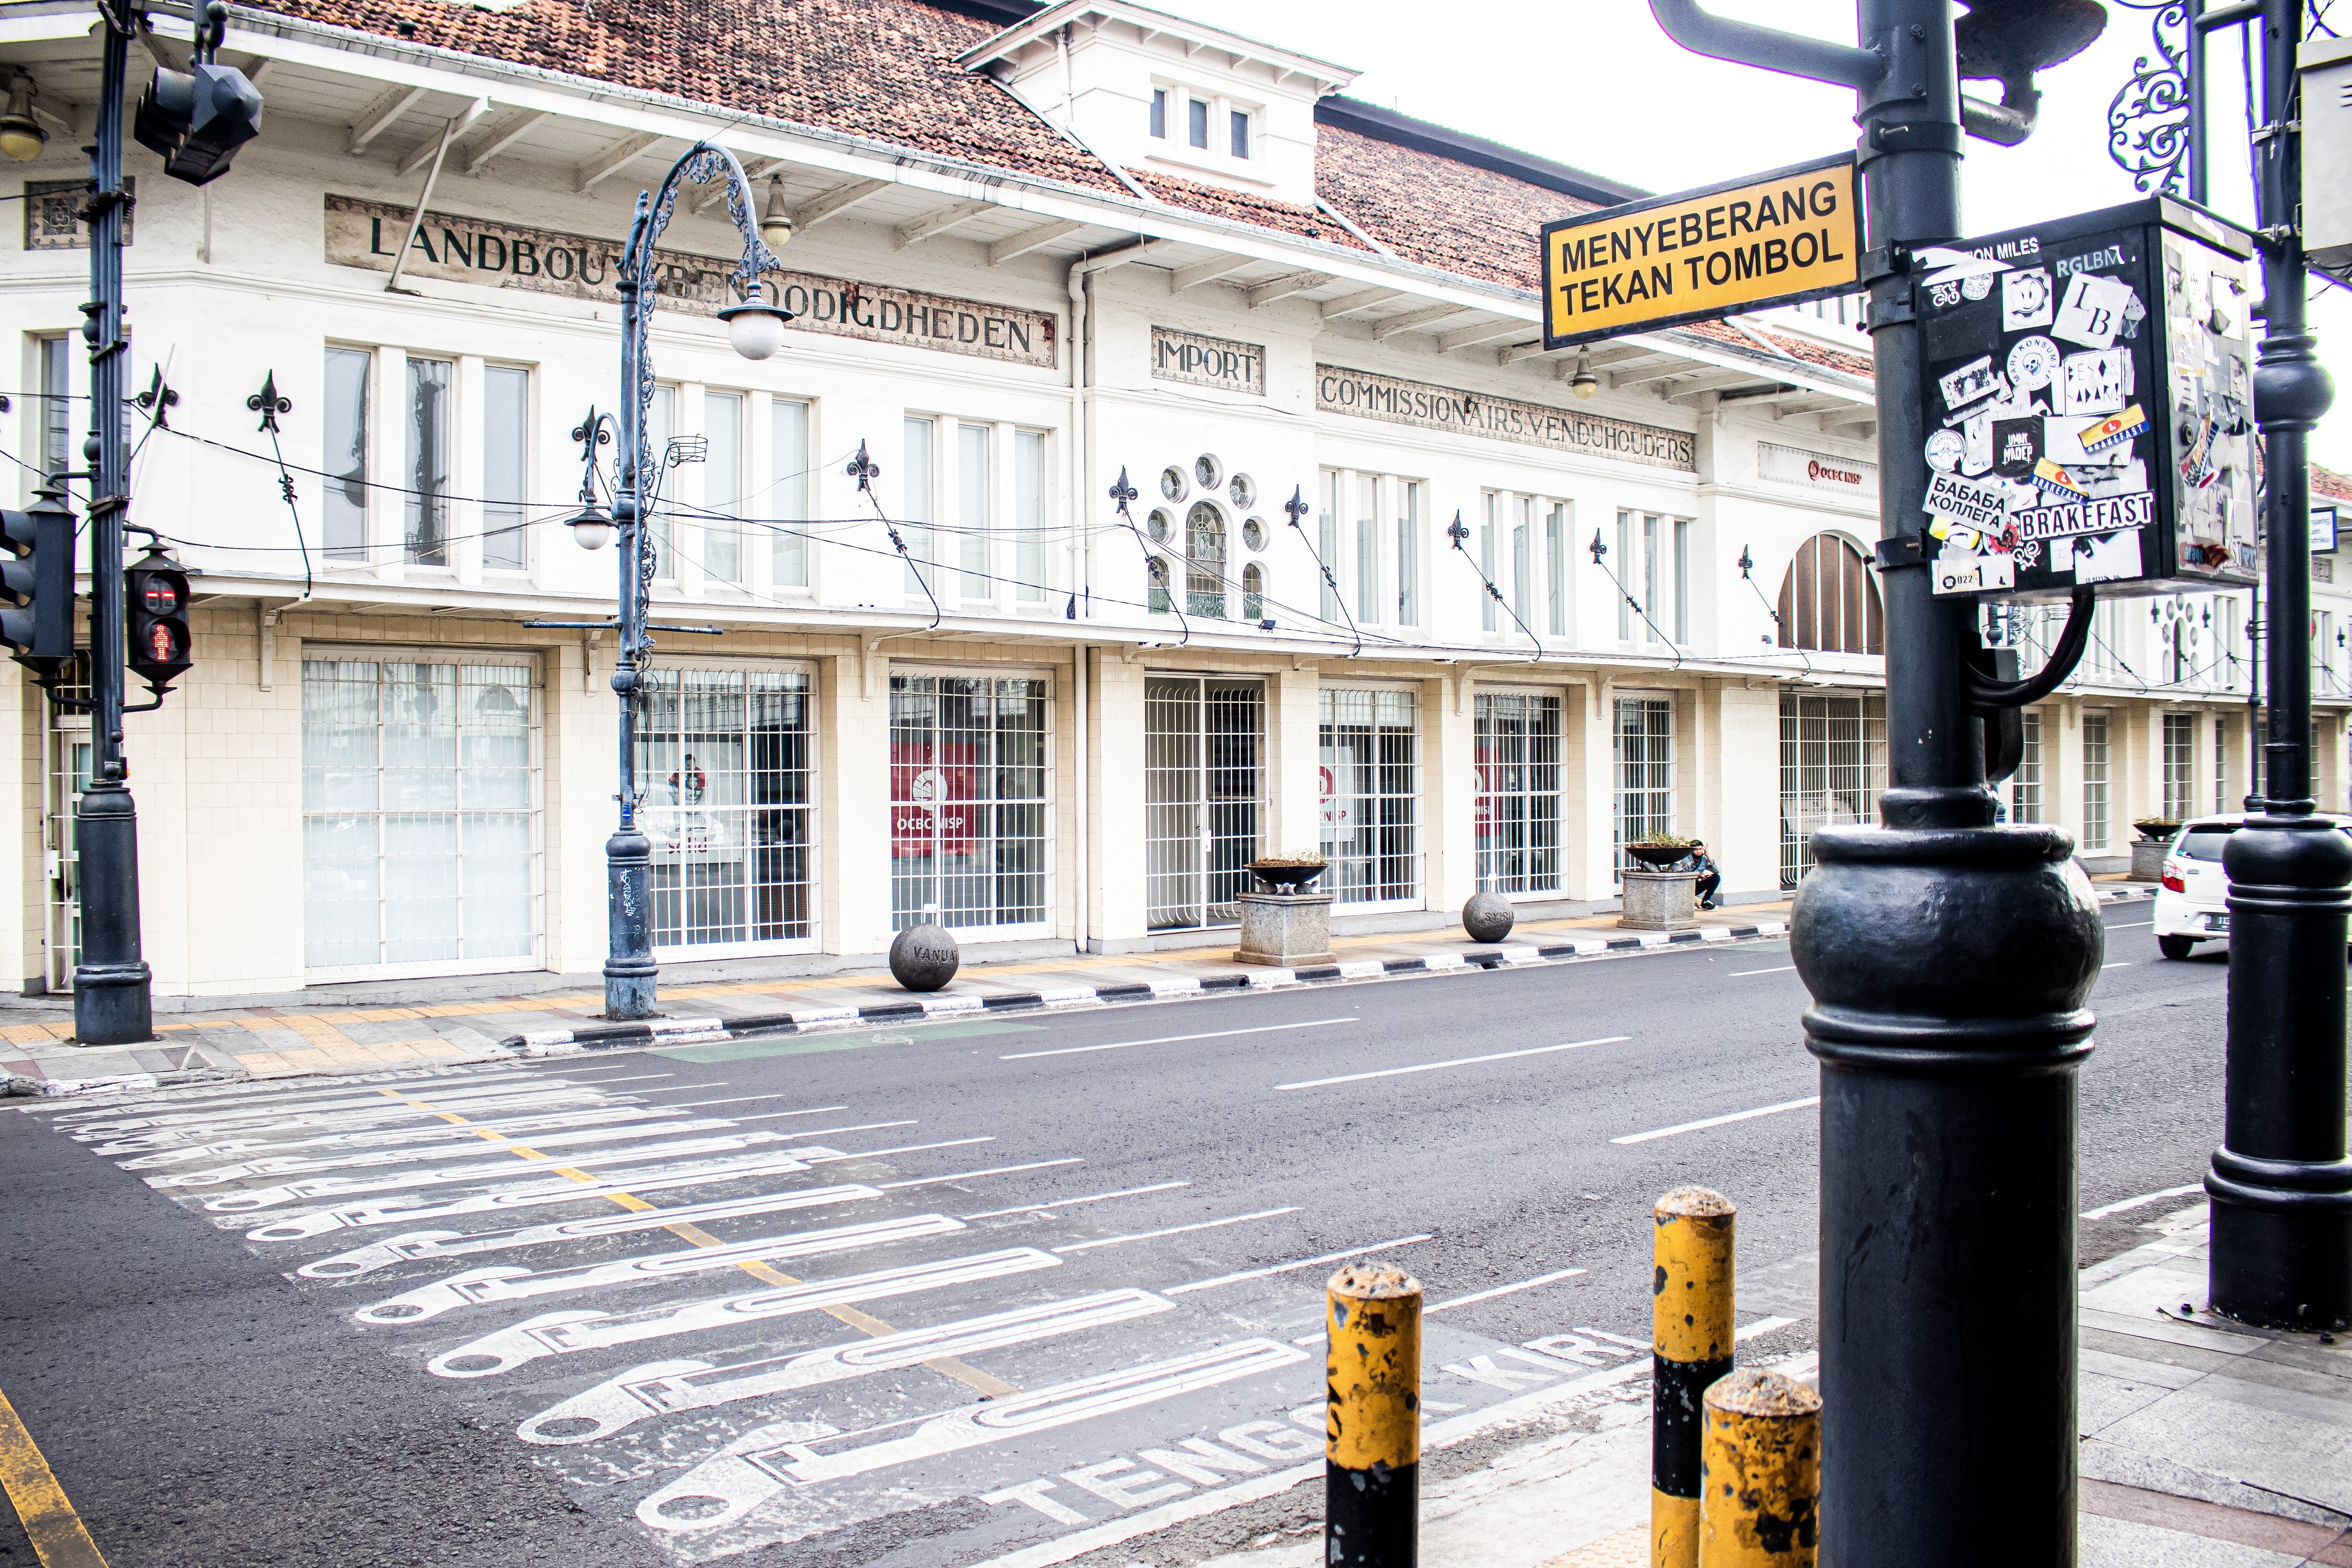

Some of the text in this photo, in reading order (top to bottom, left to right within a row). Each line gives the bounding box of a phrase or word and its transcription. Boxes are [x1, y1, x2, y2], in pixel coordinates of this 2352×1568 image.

[1562, 181, 1837, 274] MENYEBERANG
[1997, 237, 2039, 260] MILES
[1559, 229, 1844, 316] TEKAN TOMBOL
[1157, 339, 1257, 382] IMPORT
[2010, 355, 2021, 382] MARI
[2088, 423, 2143, 453] BRAKEFAST
[1934, 477, 2005, 514] БАБАБА
[2032, 475, 2084, 503] BRAKEFAST
[1929, 493, 2000, 528] КОЛЛЕГА
[2023, 495, 2151, 537] BRAKEFAST
[897, 817, 932, 830] OCBC
[978, 1327, 1653, 1526] TENG KIRI
